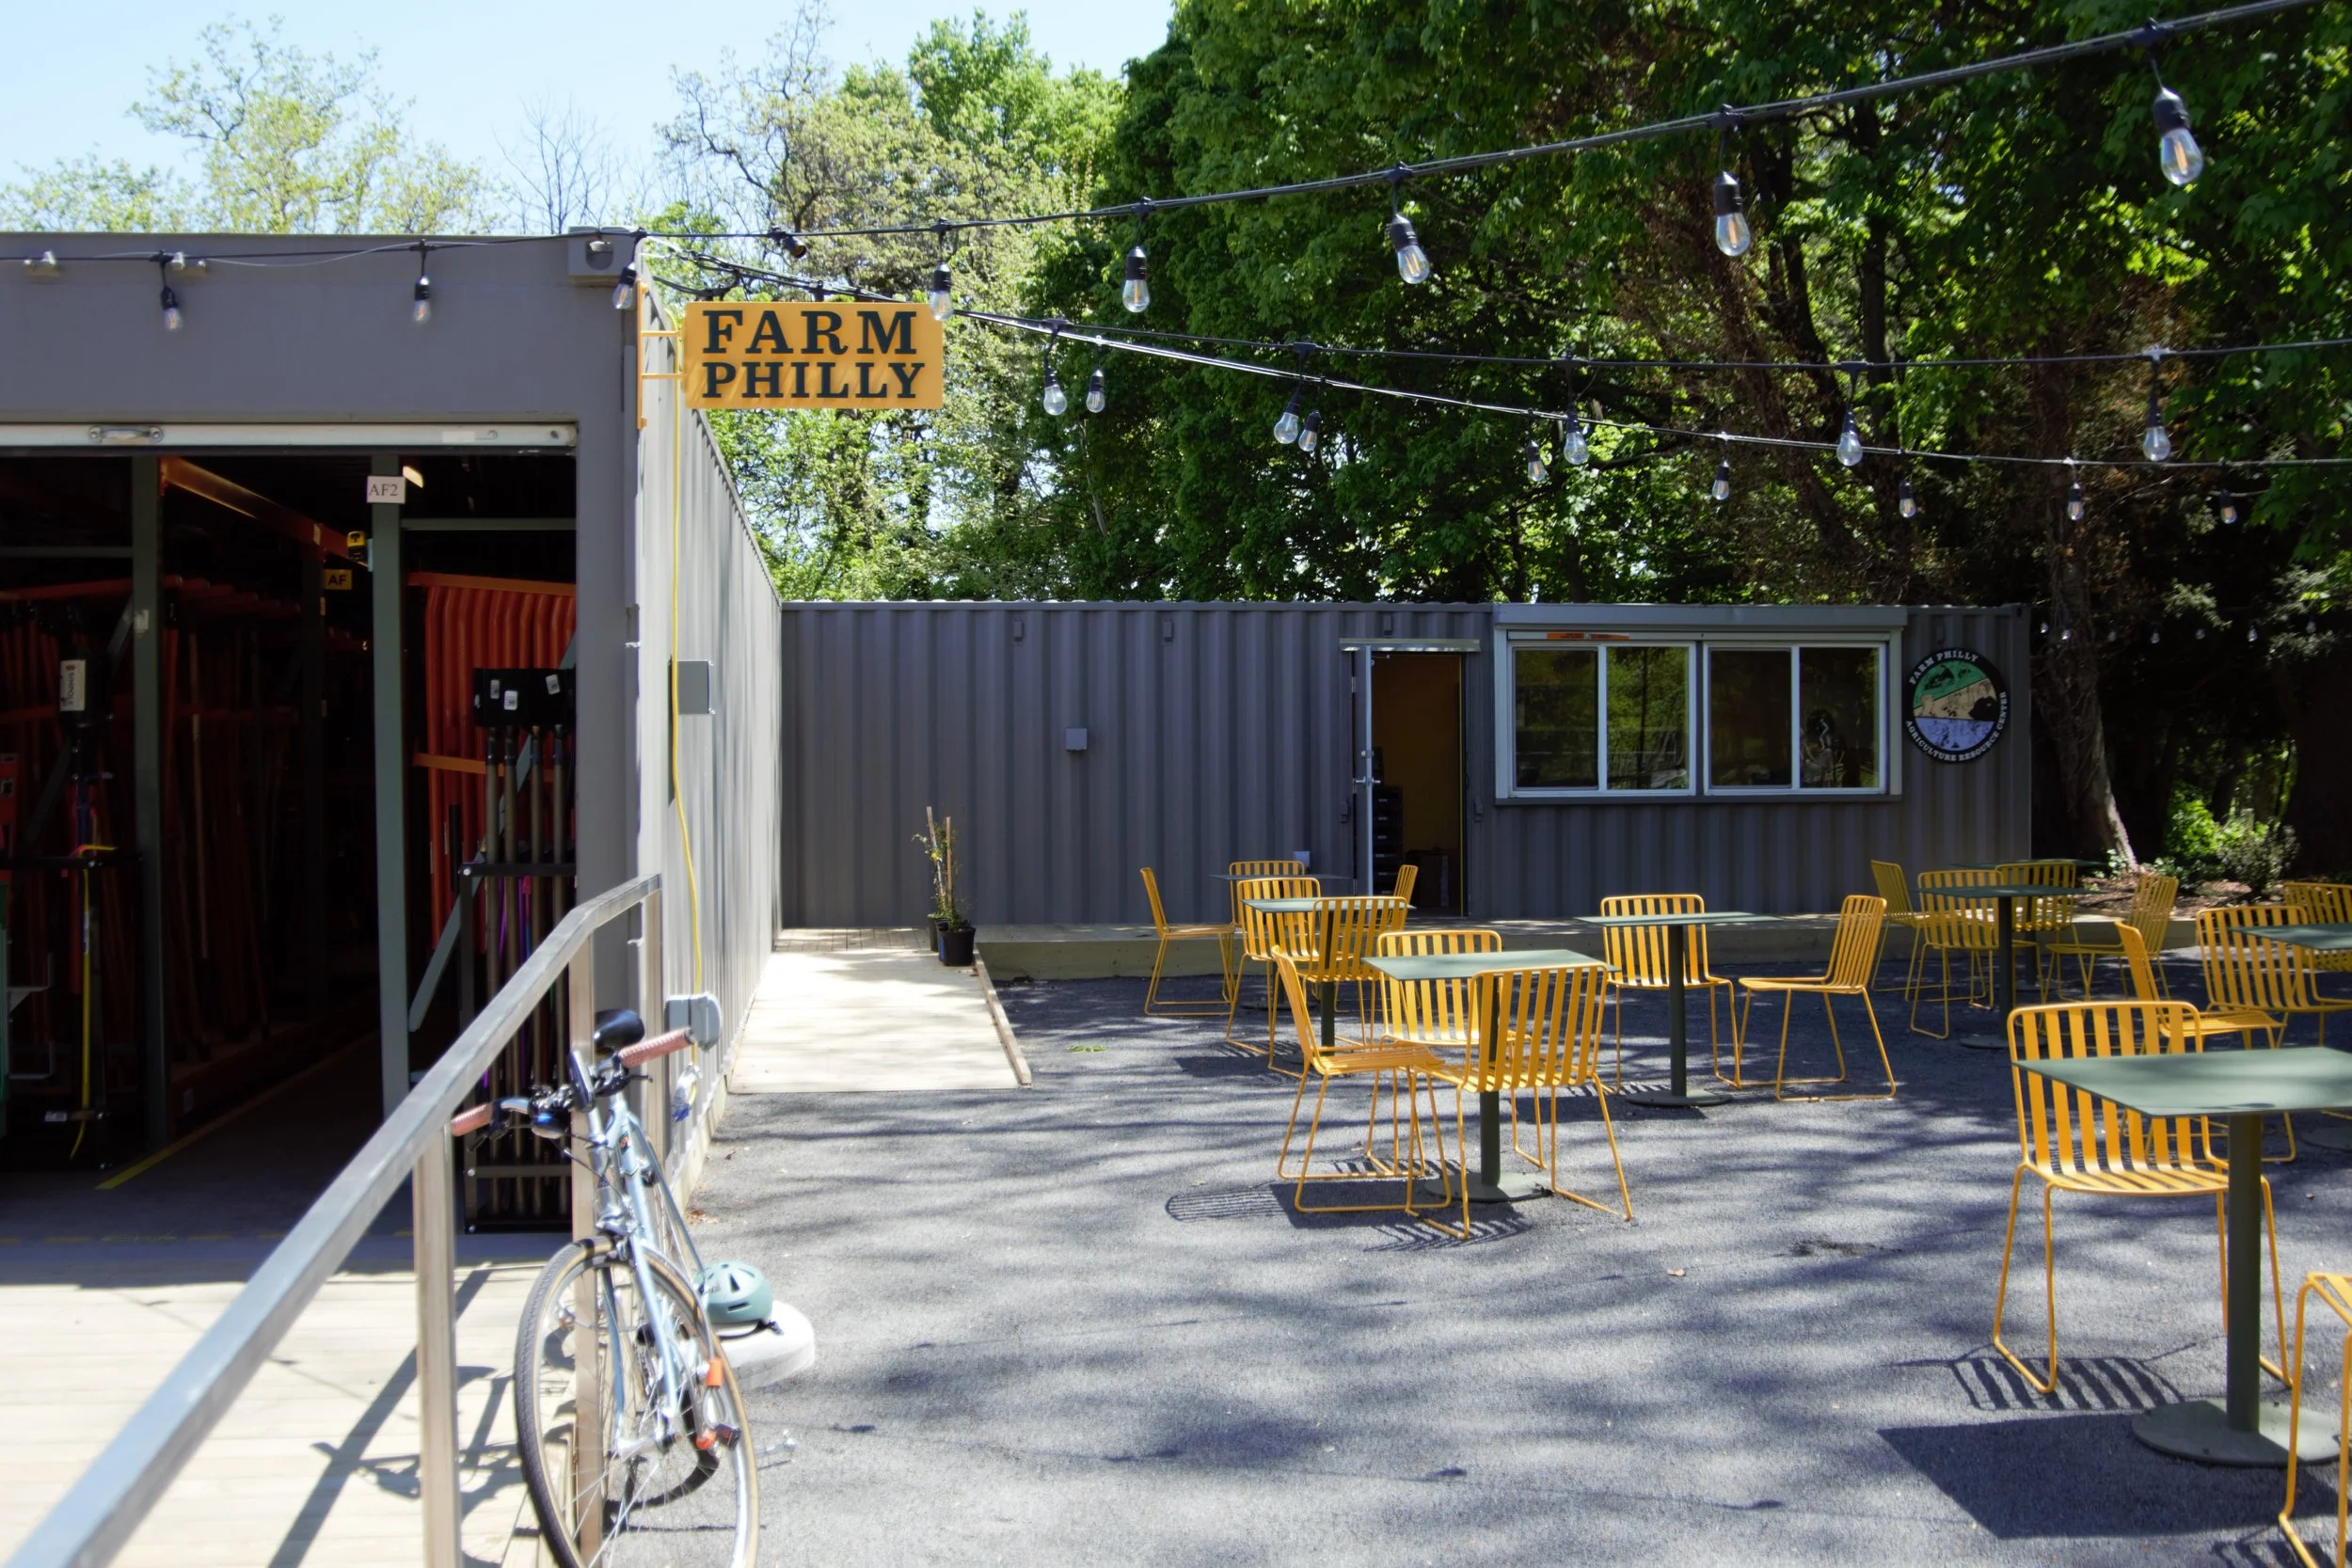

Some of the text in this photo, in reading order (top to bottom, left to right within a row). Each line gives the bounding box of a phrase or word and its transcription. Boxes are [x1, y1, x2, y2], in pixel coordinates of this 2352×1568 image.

[702, 309, 916, 356] FARM
[702, 361, 925, 399] PHILLY
[369, 483, 398, 497] AF2
[327, 575, 346, 585] AF
[1909, 649, 1979, 685] FARM PHILLY
[1906, 691, 2008, 761] AGRICULTURE RESOURCE CENTER
